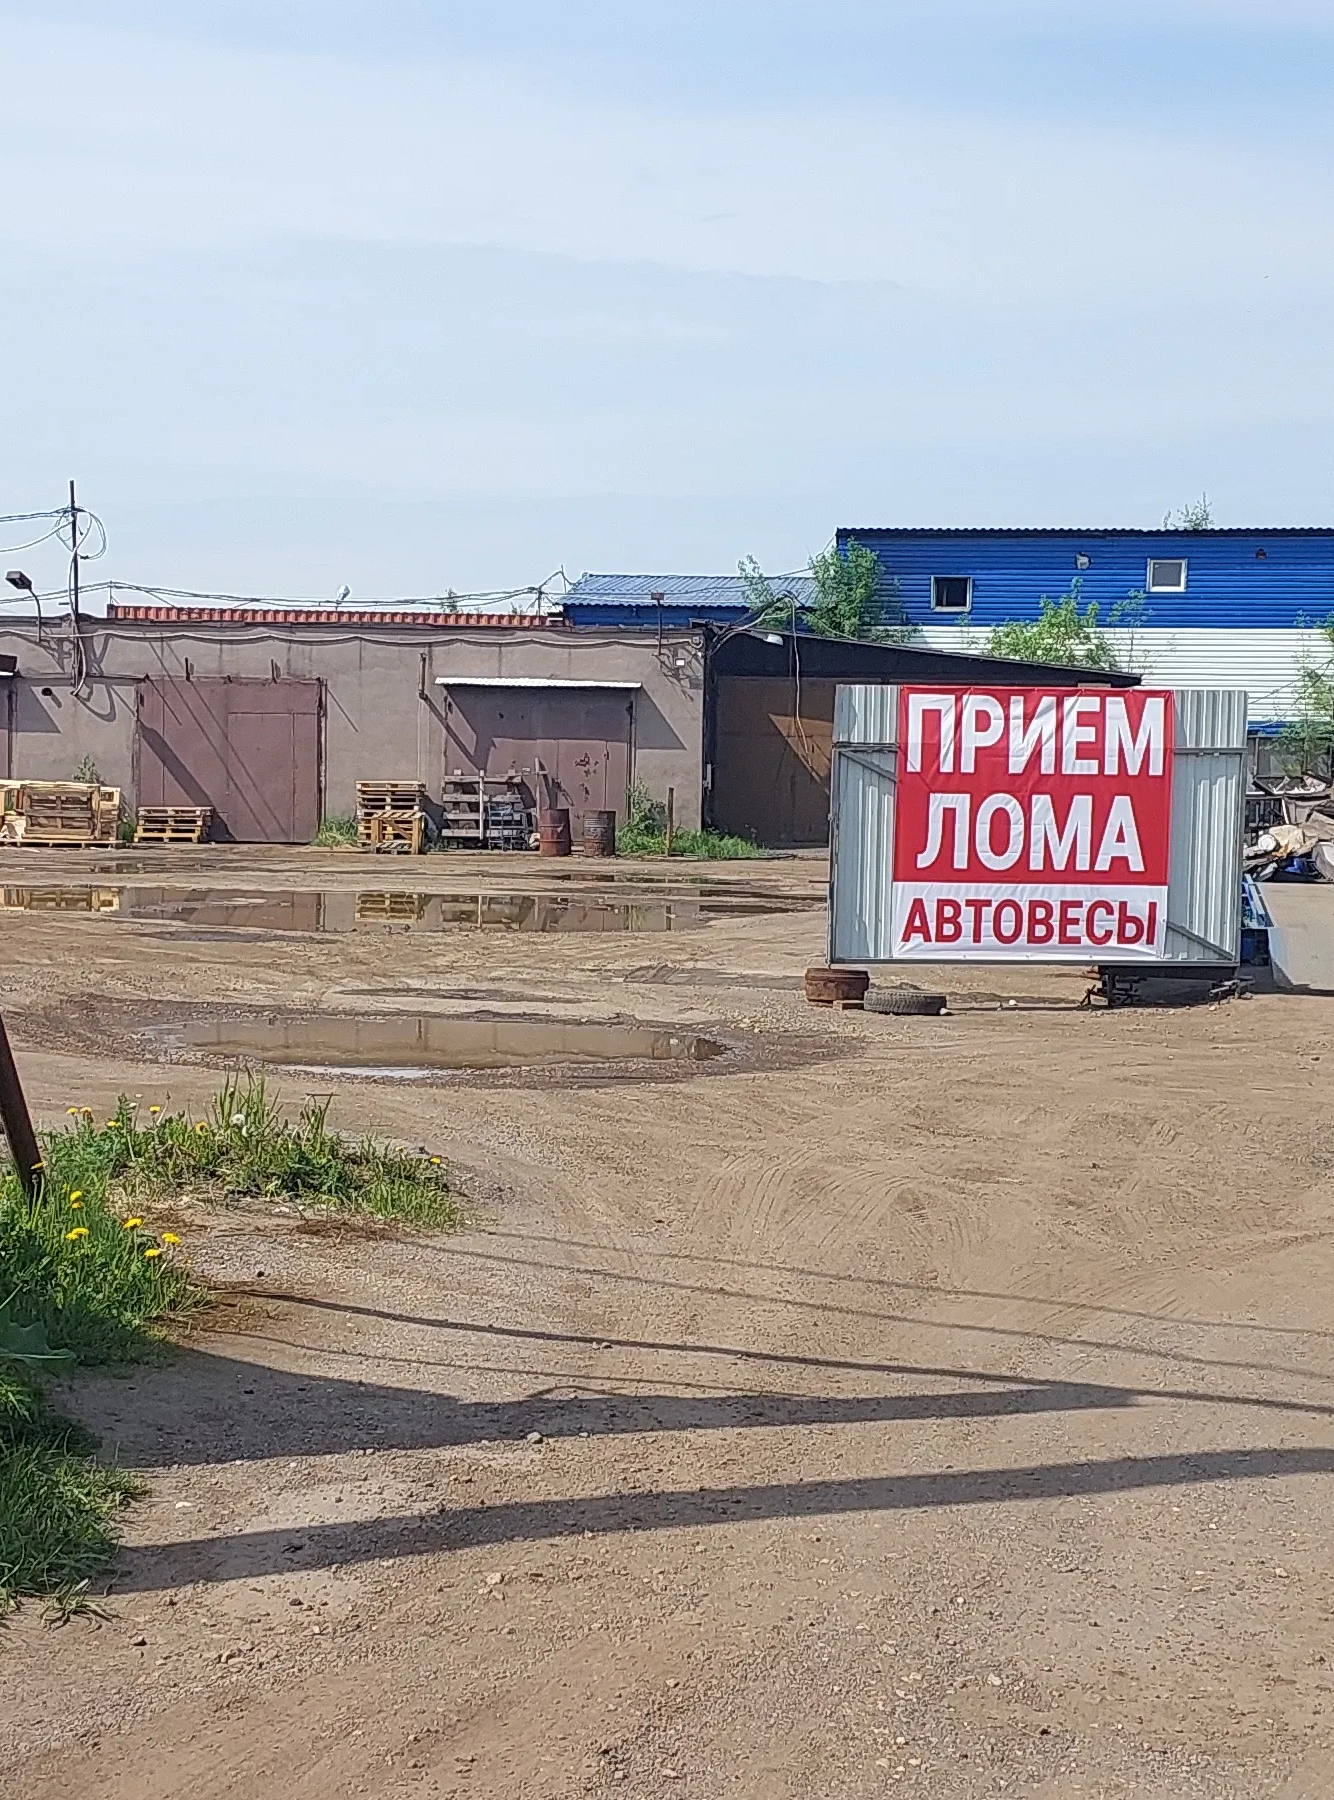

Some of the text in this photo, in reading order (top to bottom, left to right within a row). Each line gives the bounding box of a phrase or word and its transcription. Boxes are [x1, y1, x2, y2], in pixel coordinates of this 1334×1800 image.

[906, 693, 1165, 776] ПРИЕМ
[916, 792, 1146, 872] ЛОМА
[901, 897, 1158, 946] АВТОВЕСЫ
